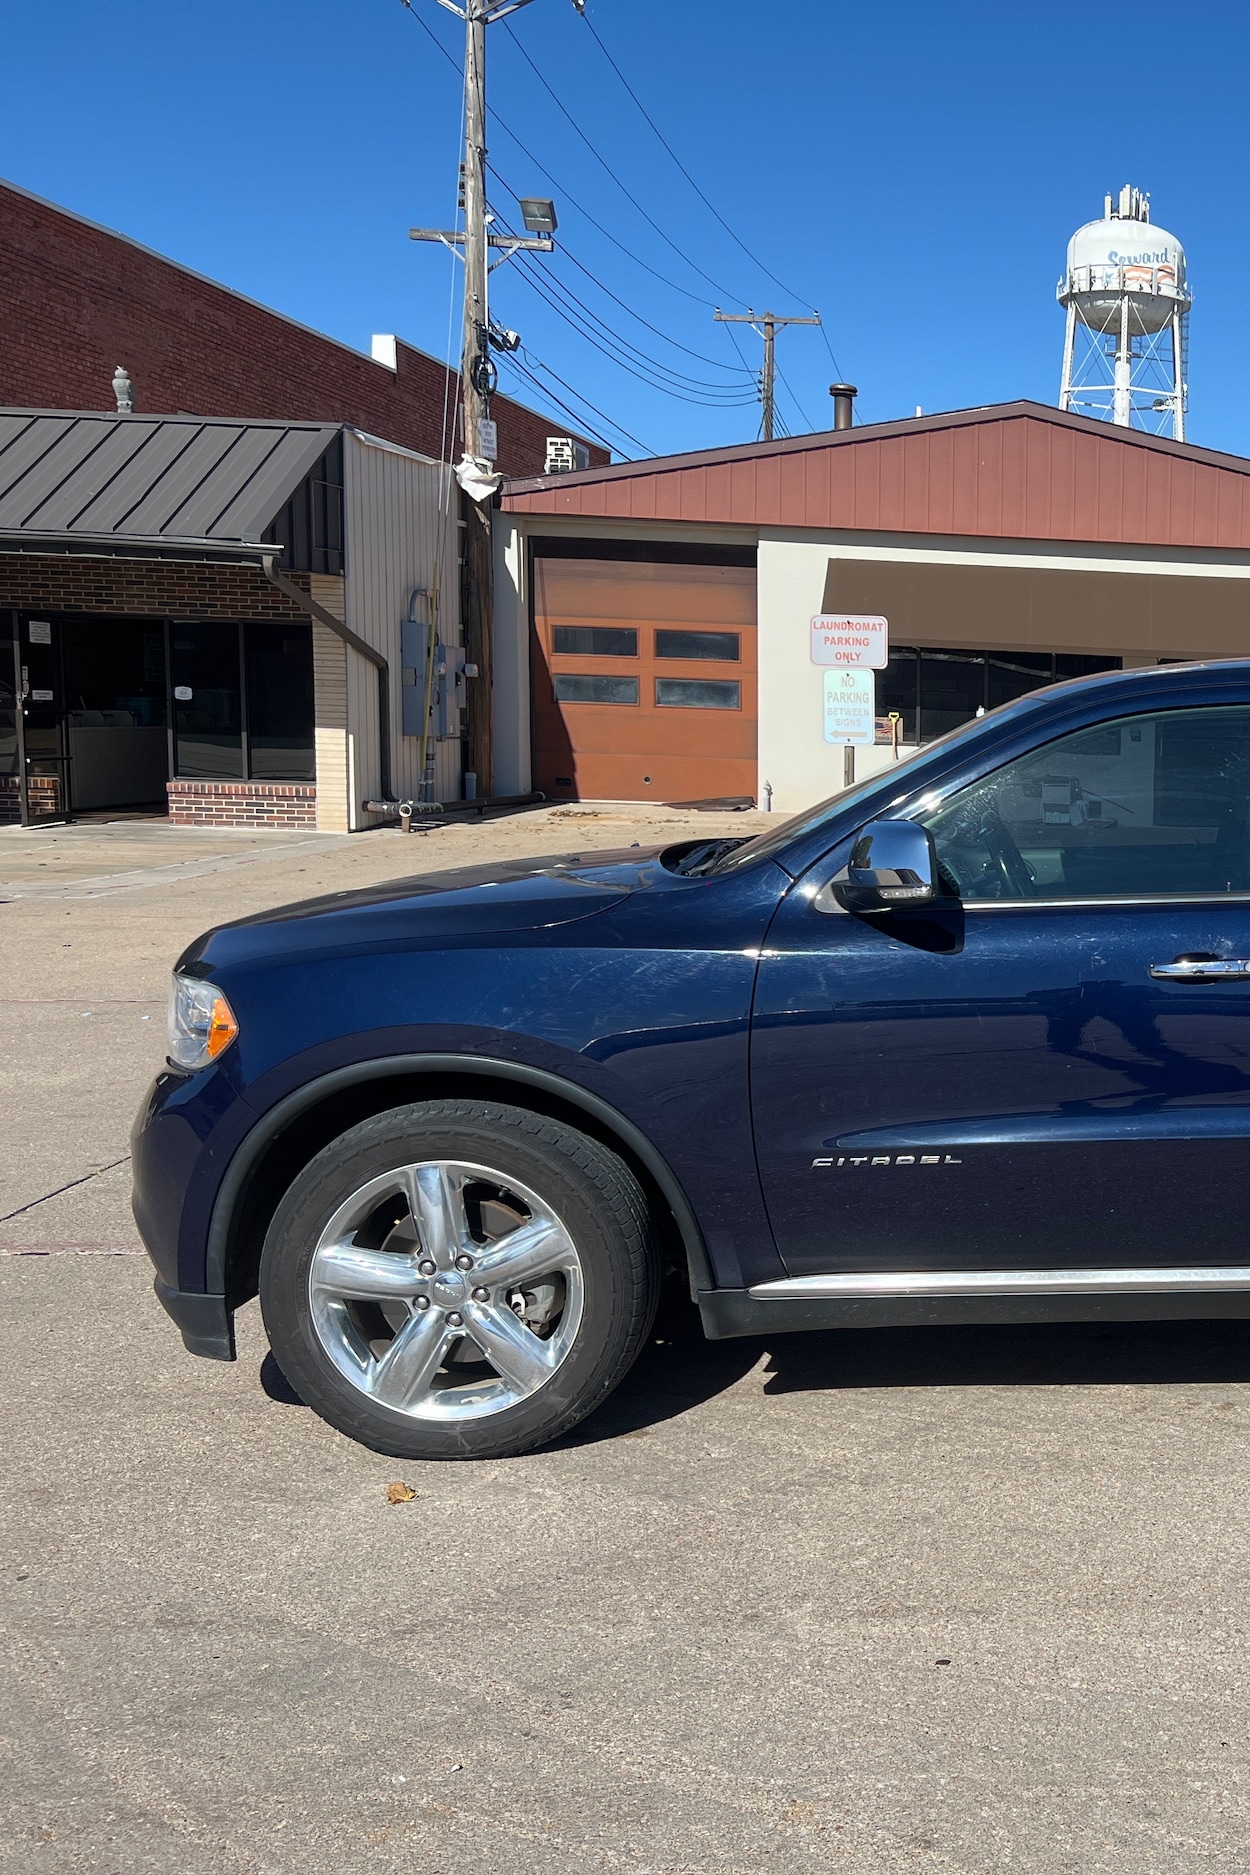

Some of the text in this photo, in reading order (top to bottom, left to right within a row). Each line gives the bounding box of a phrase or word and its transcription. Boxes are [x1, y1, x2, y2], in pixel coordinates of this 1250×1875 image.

[1108, 248, 1171, 267] Seward
[813, 621, 884, 632] LAUNDROMAT
[824, 636, 870, 647] PARKING
[835, 652, 862, 661] ONLY
[841, 676, 855, 688] NO
[827, 691, 870, 704] PARKING
[827, 707, 870, 717] BETWEEN
[835, 718, 862, 727] SIGNS
[810, 1155, 963, 1170] CITADEL
